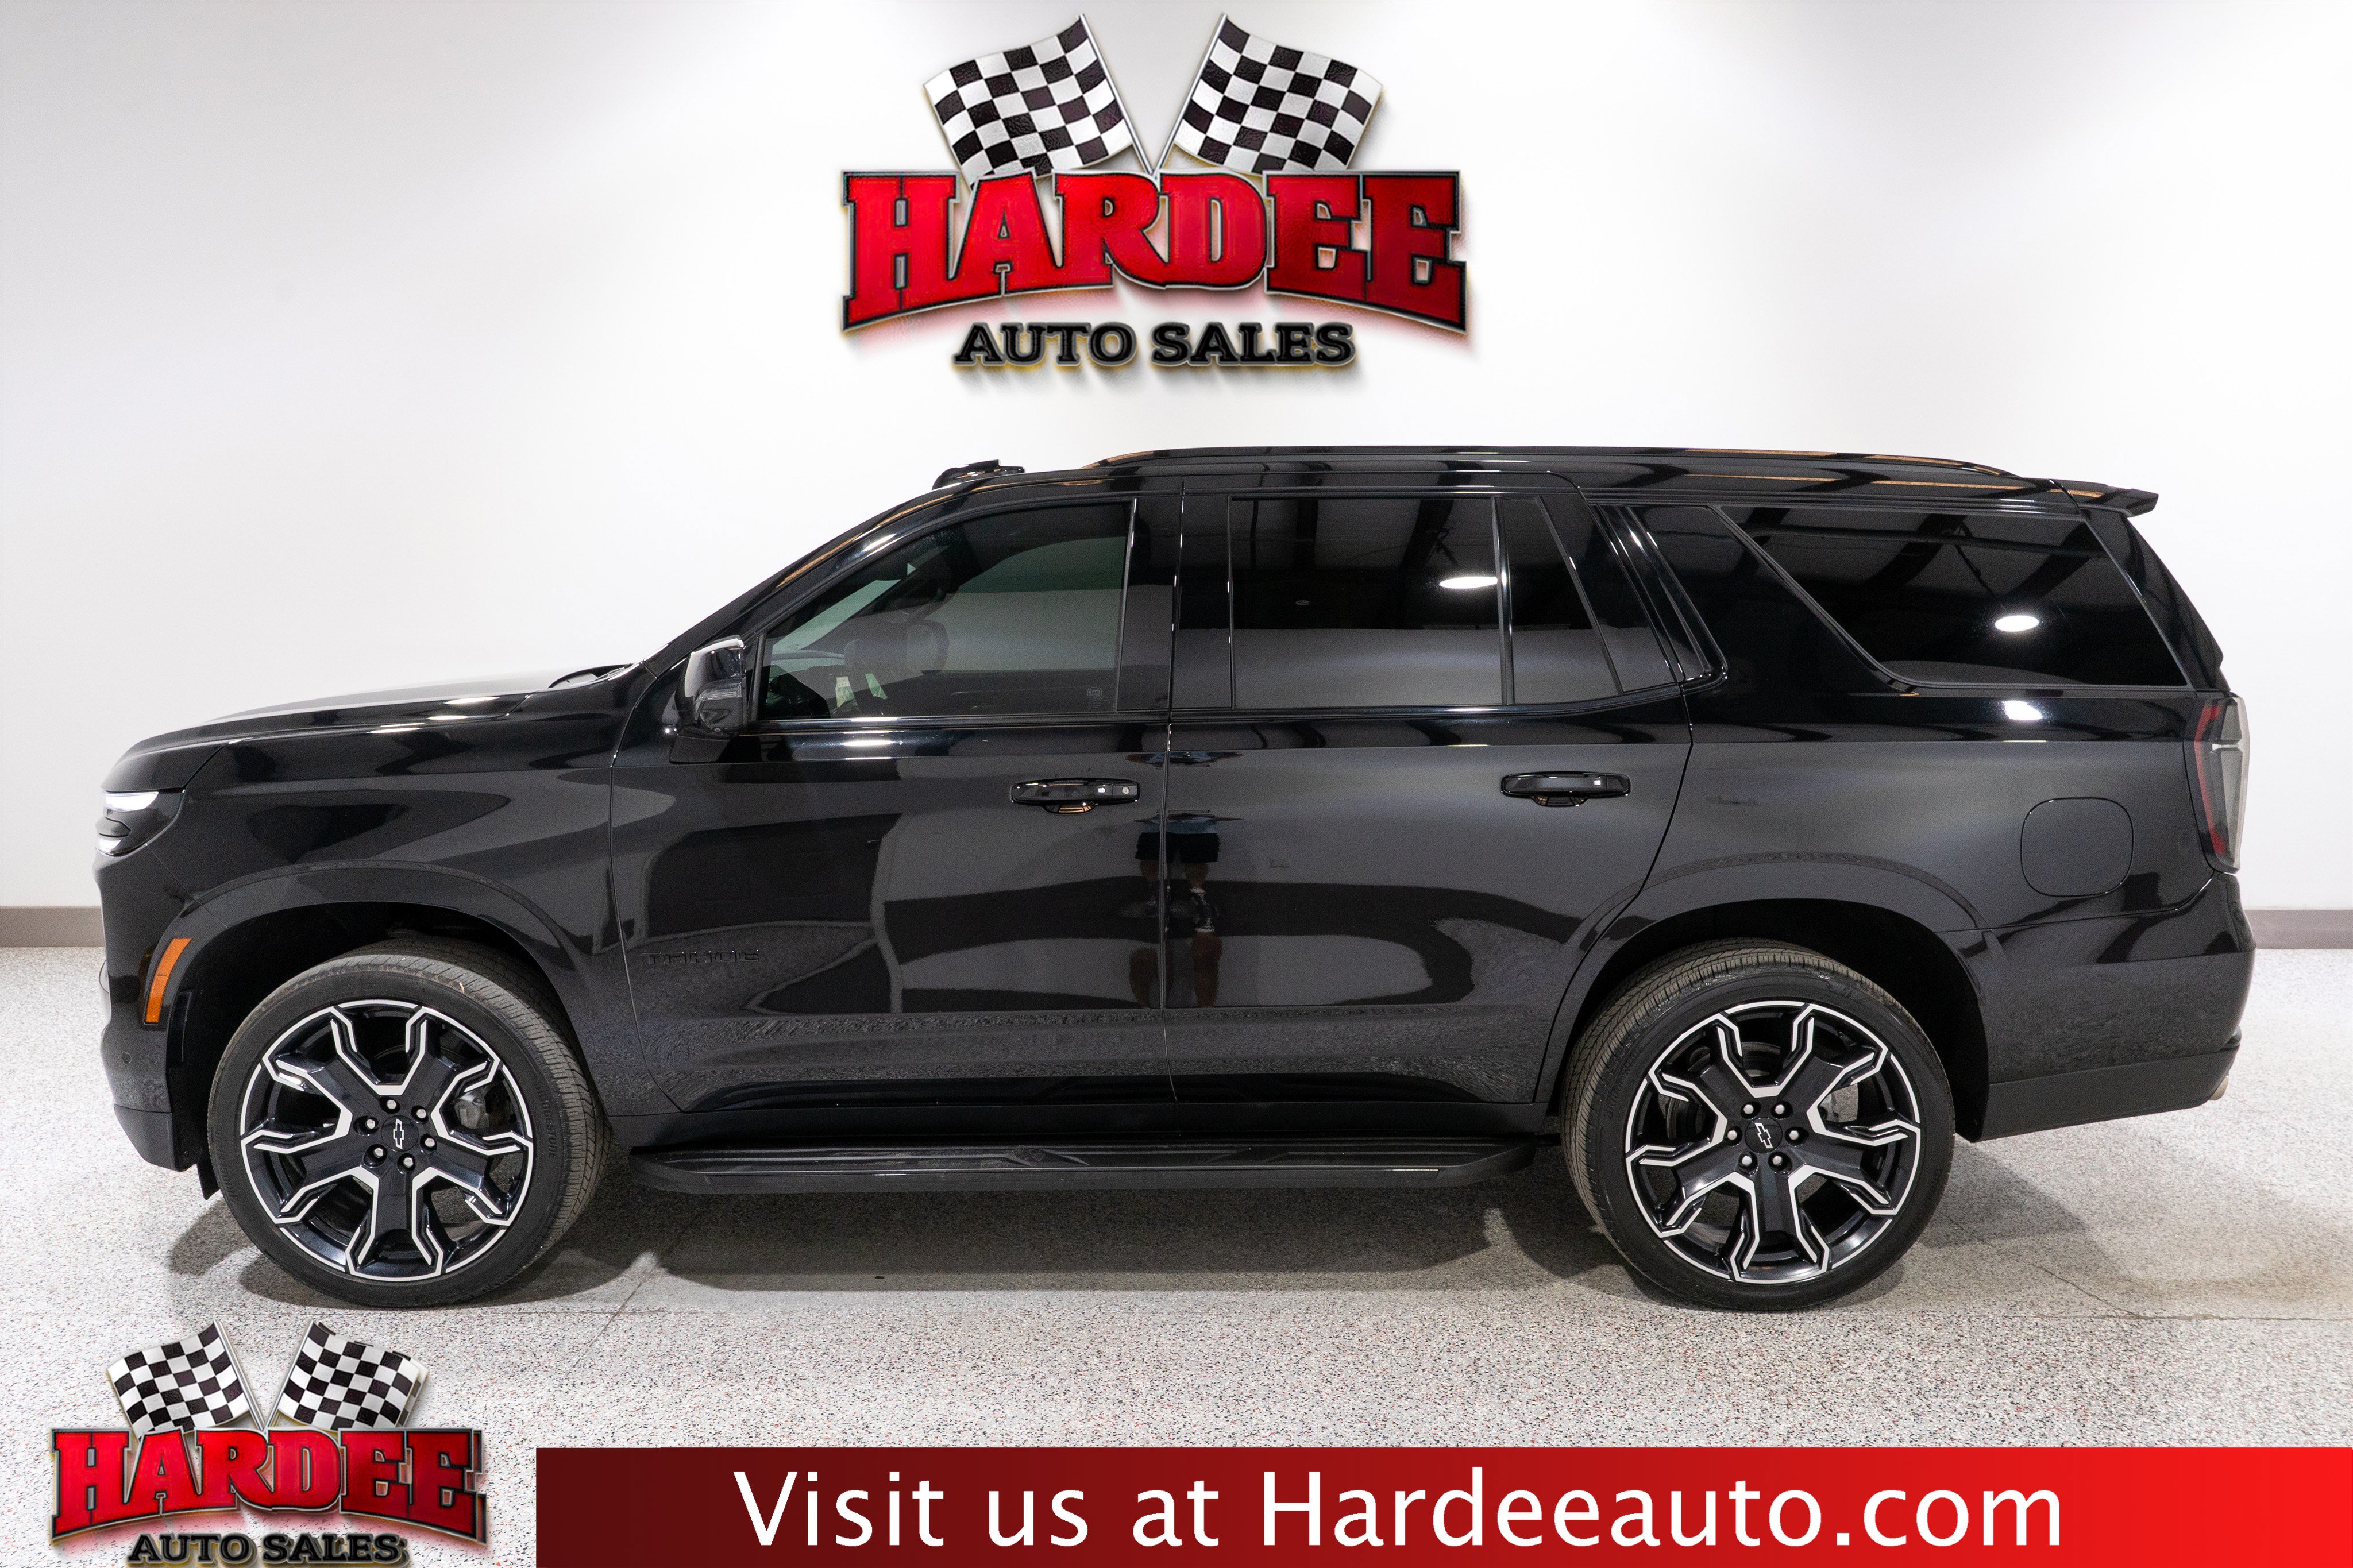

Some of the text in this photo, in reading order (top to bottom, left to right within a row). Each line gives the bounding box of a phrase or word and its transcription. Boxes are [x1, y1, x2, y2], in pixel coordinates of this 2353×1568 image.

[841, 168, 1467, 334] HARDEE
[952, 322, 1357, 366] AUTO SALES
[640, 950, 760, 964] TAHOE
